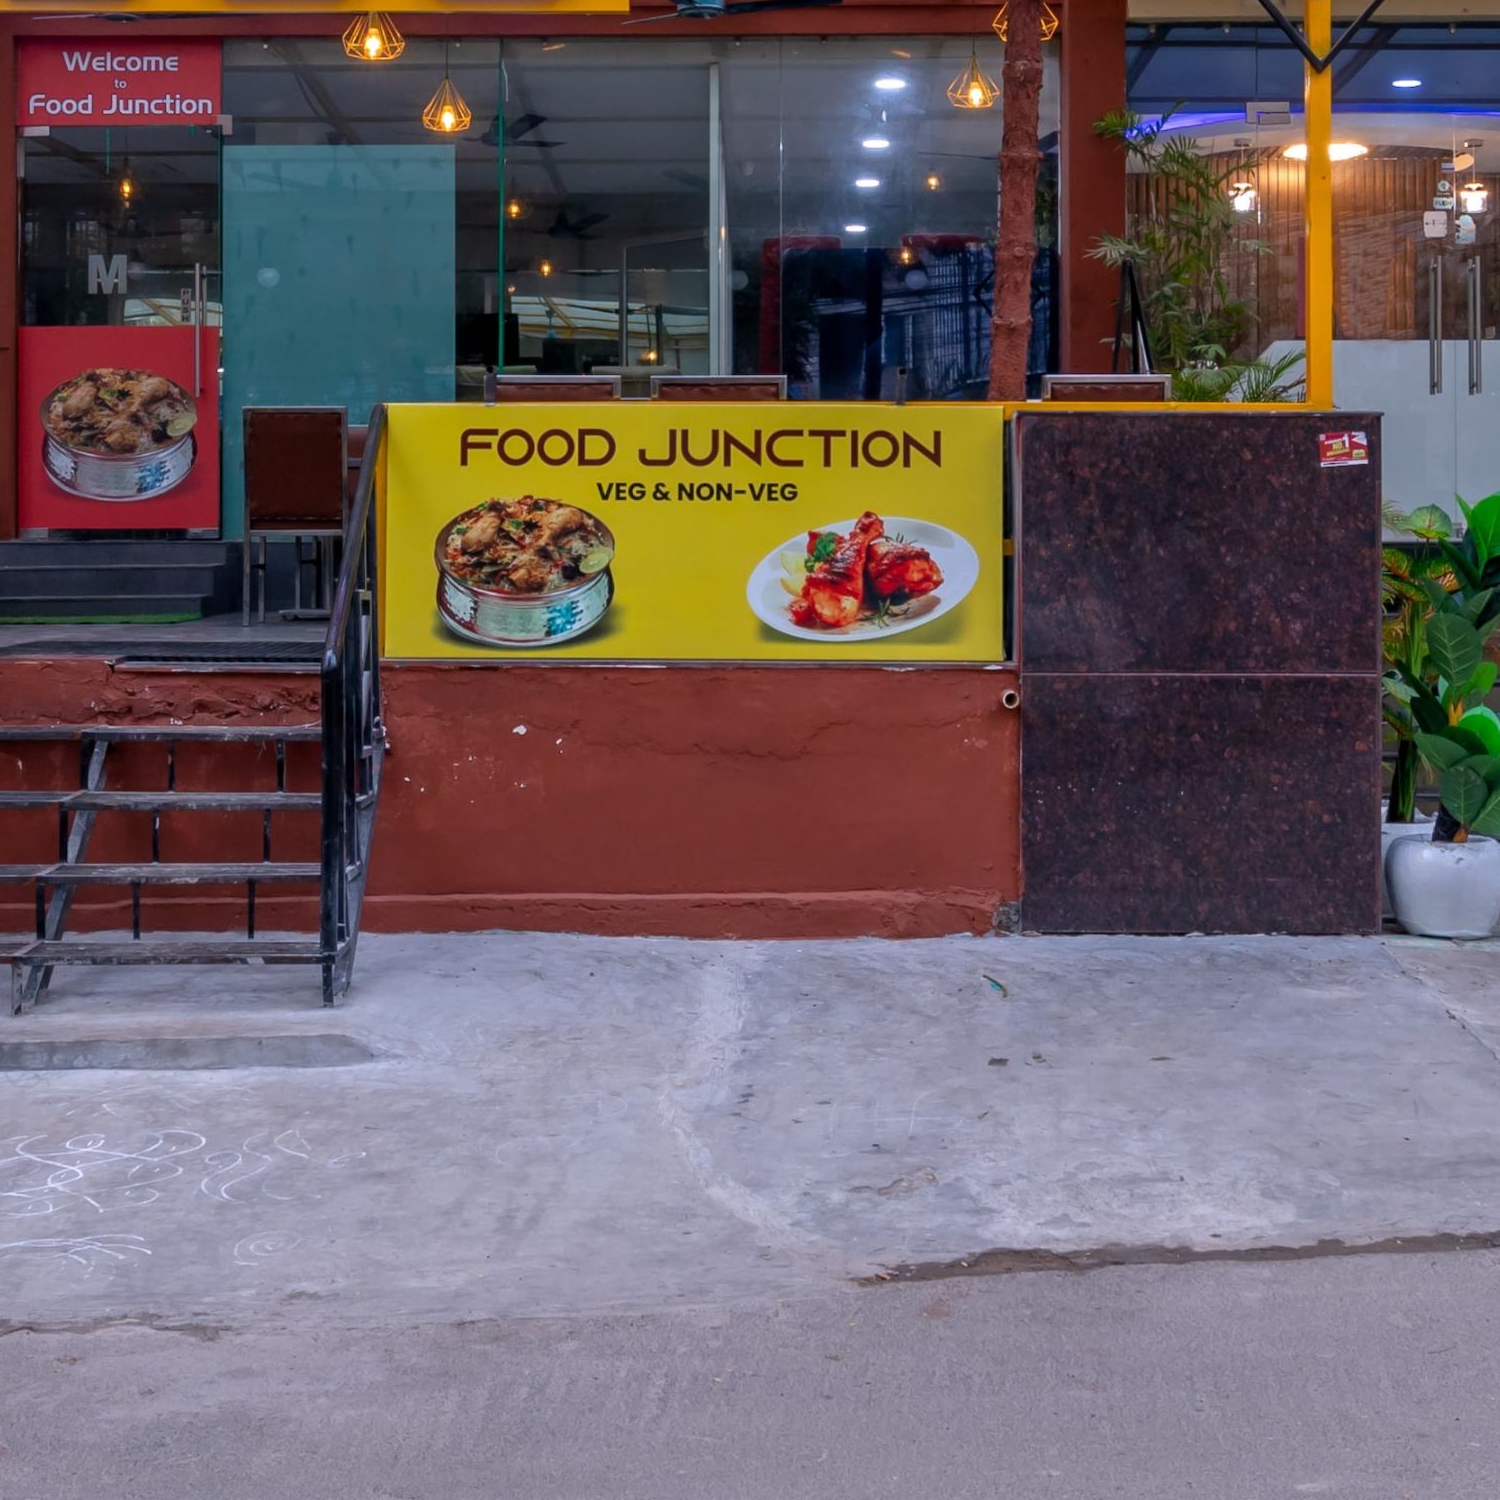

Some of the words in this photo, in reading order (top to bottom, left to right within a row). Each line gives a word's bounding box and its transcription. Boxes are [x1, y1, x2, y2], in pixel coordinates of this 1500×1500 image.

[62, 51, 179, 72] Welcome
[114, 78, 127, 89] to
[29, 94, 93, 114] Food
[103, 94, 213, 114] Junction
[460, 428, 617, 467] FOOD
[638, 428, 942, 468] JUNCTION
[596, 482, 647, 501] VEG
[652, 482, 670, 501] &
[677, 482, 799, 502] NON-VEG
